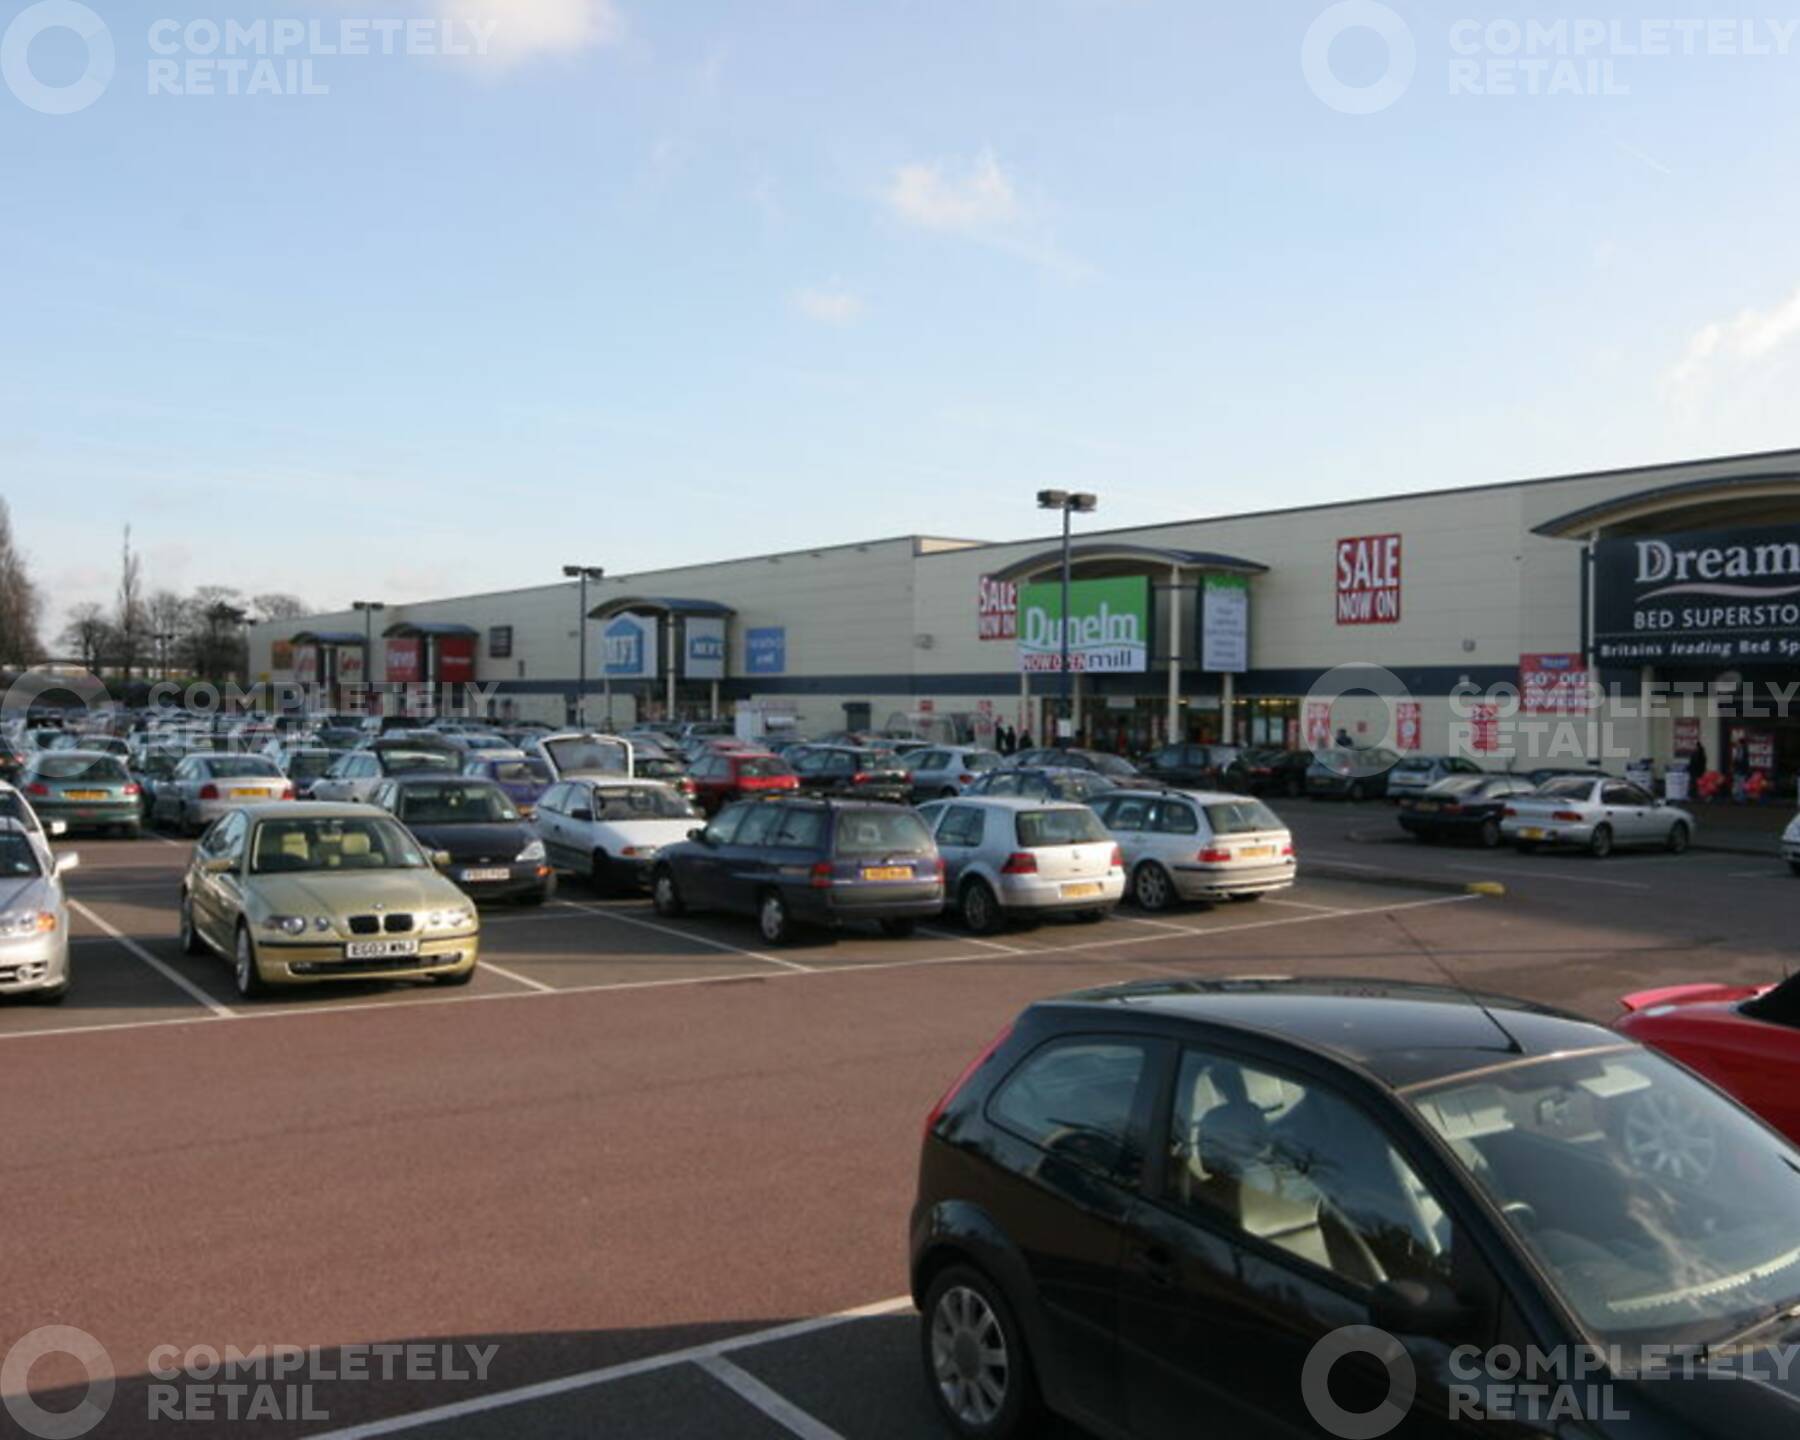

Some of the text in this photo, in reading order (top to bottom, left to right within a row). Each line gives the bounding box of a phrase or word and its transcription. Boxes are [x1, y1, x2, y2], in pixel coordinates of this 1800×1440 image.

[1339, 538, 1398, 589] SALE
[980, 576, 1017, 612] SALE
[1339, 590, 1397, 620] NOW ON
[1026, 602, 1138, 648] Dunelm
[1634, 604, 1799, 629] BED SUPERSTO
[1088, 650, 1132, 667] mill
[1600, 643, 1662, 657] Britains
[1671, 641, 1732, 657] leading
[1739, 639, 1770, 653] Bed
[1024, 654, 1049, 670] NOW
